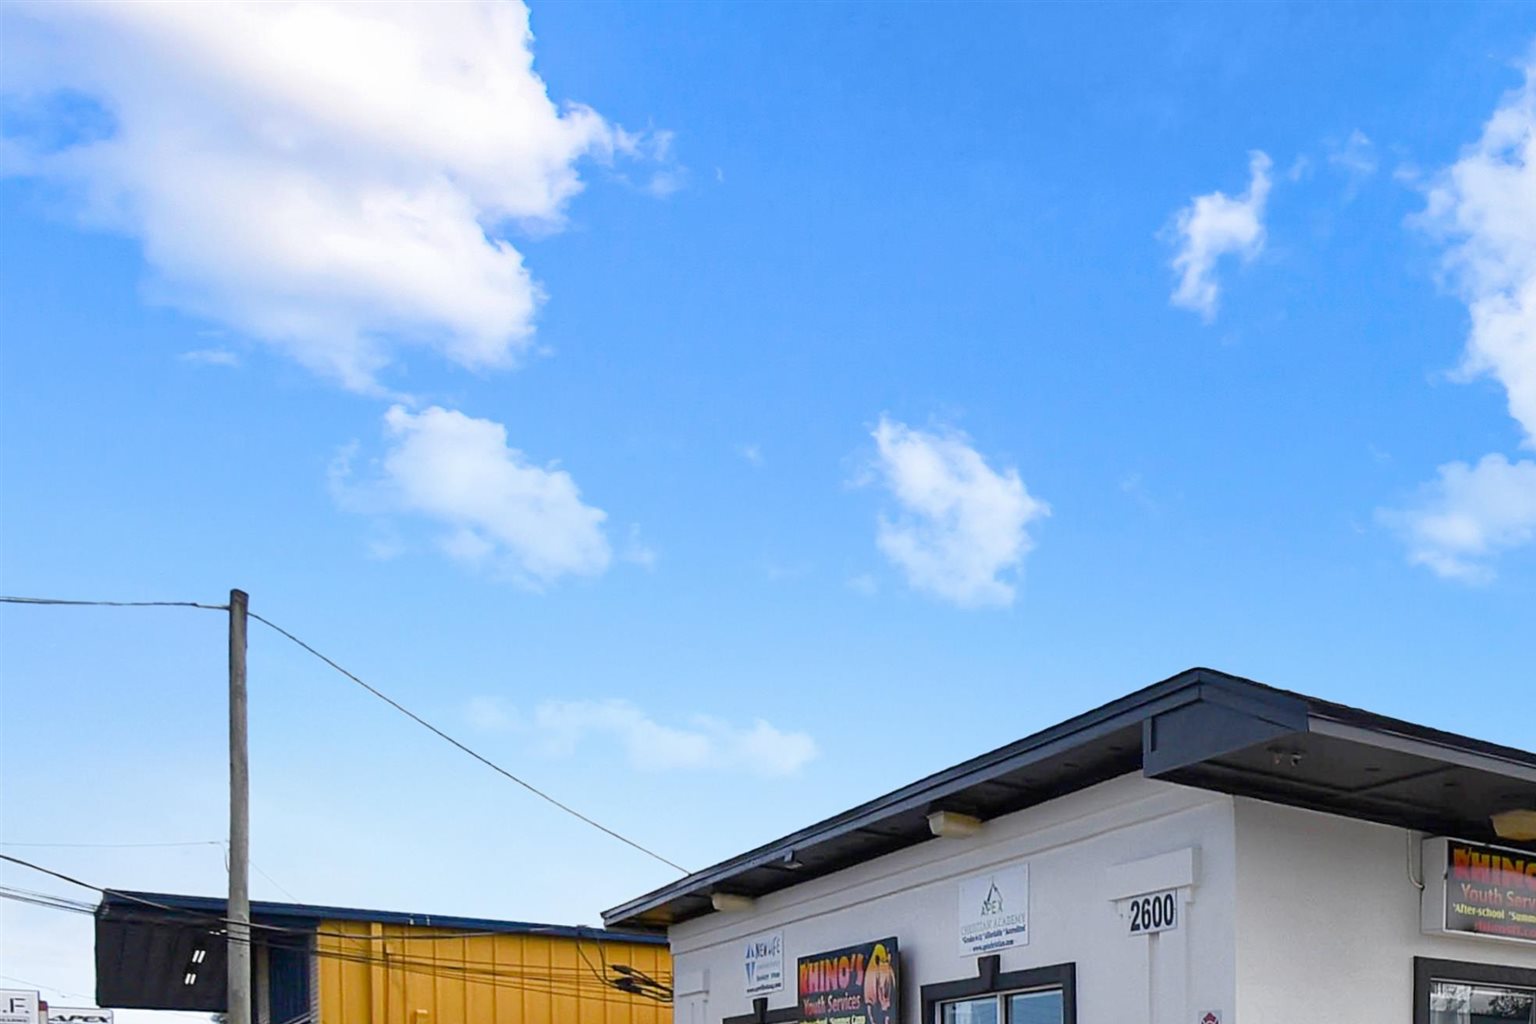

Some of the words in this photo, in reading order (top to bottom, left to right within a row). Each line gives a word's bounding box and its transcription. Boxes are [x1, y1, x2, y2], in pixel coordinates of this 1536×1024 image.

[1461, 883, 1502, 906] Youth
[1130, 894, 1174, 931] 2600
[827, 992, 861, 1013] Services
